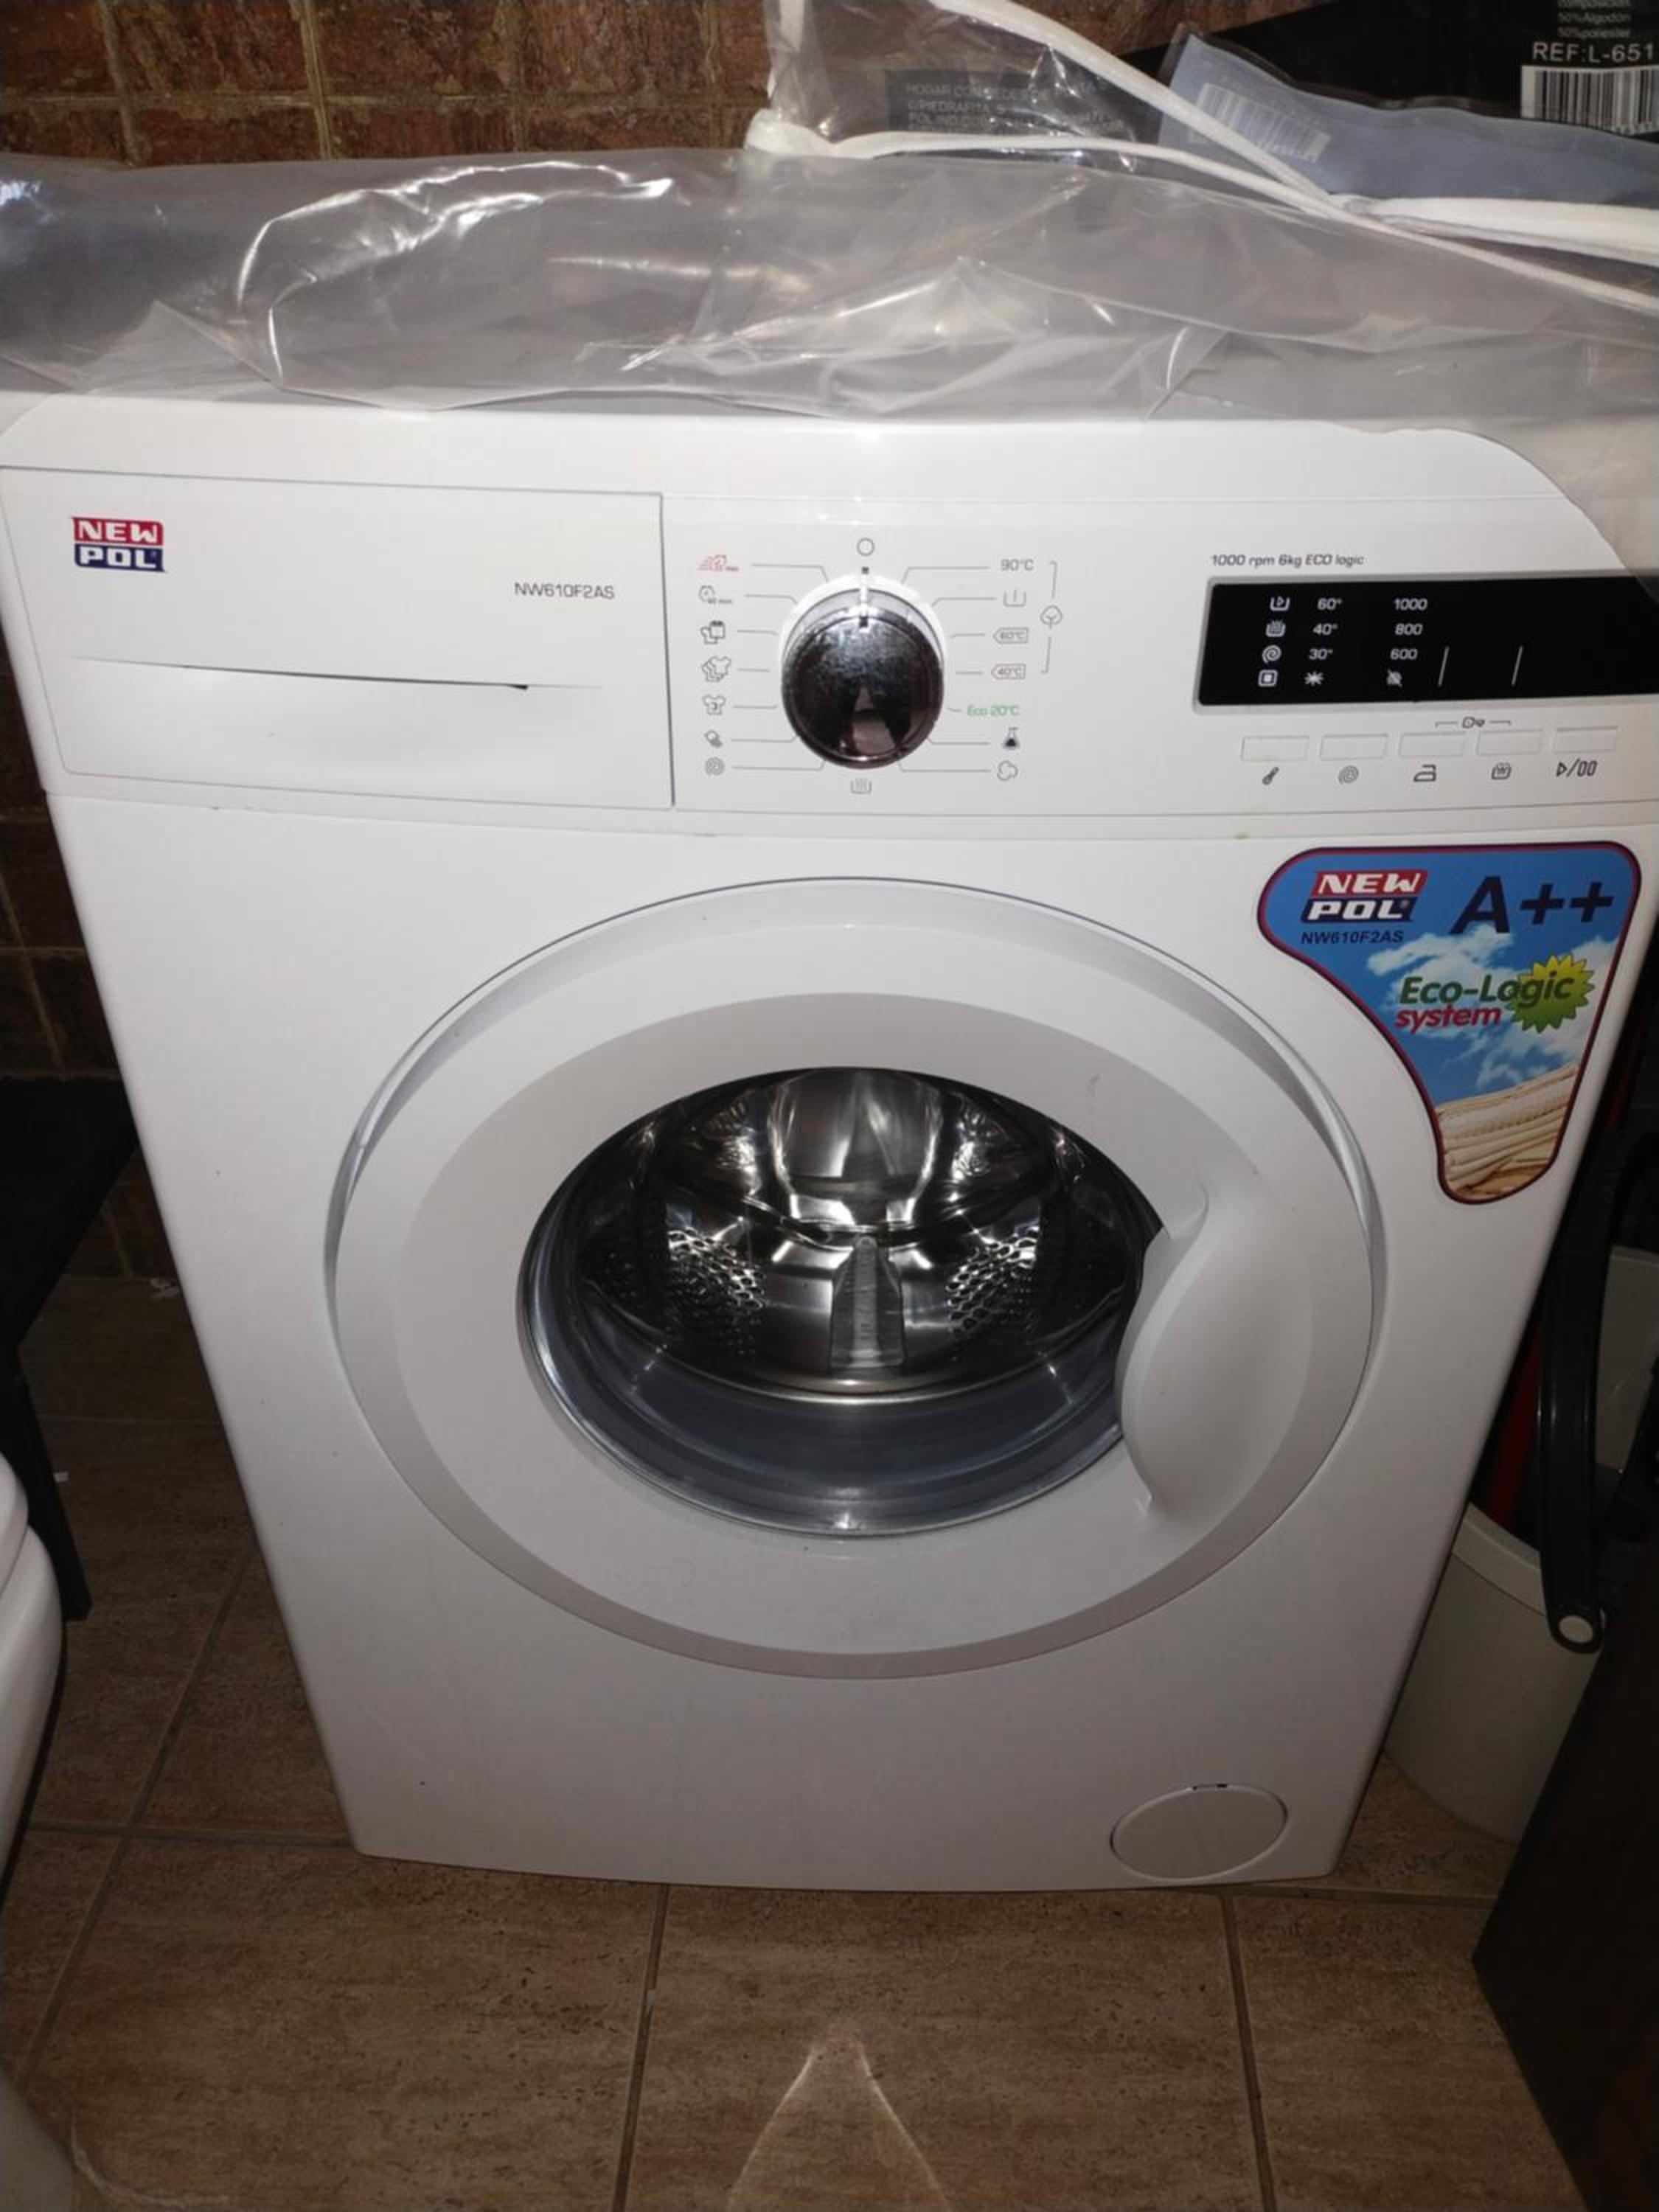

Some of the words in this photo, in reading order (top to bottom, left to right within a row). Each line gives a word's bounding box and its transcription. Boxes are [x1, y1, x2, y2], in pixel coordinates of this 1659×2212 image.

[78, 519, 158, 543] NEW
[79, 546, 157, 568] POL
[1212, 554, 1246, 566] 1000
[1249, 557, 1275, 568] rpm
[1278, 554, 1302, 568] 6kg
[1305, 554, 1333, 566] ECO
[1335, 554, 1364, 568] logic
[1001, 559, 1034, 571] 90°C
[514, 581, 616, 599] NW610F2AS
[1317, 597, 1342, 611] 60°
[1394, 597, 1428, 611] 1000
[1312, 622, 1338, 636] 40°
[1394, 622, 1423, 636] 800
[1308, 647, 1333, 661] 30°
[1390, 647, 1418, 661] 600
[967, 705, 988, 717] Eco
[1318, 872, 1422, 894] NEW
[1307, 899, 1404, 921] POL
[1448, 874, 1615, 935] A++
[1301, 931, 1403, 945] NW610F2AS
[1399, 970, 1575, 1009] Eco-Logic
[1394, 1005, 1502, 1034] system
